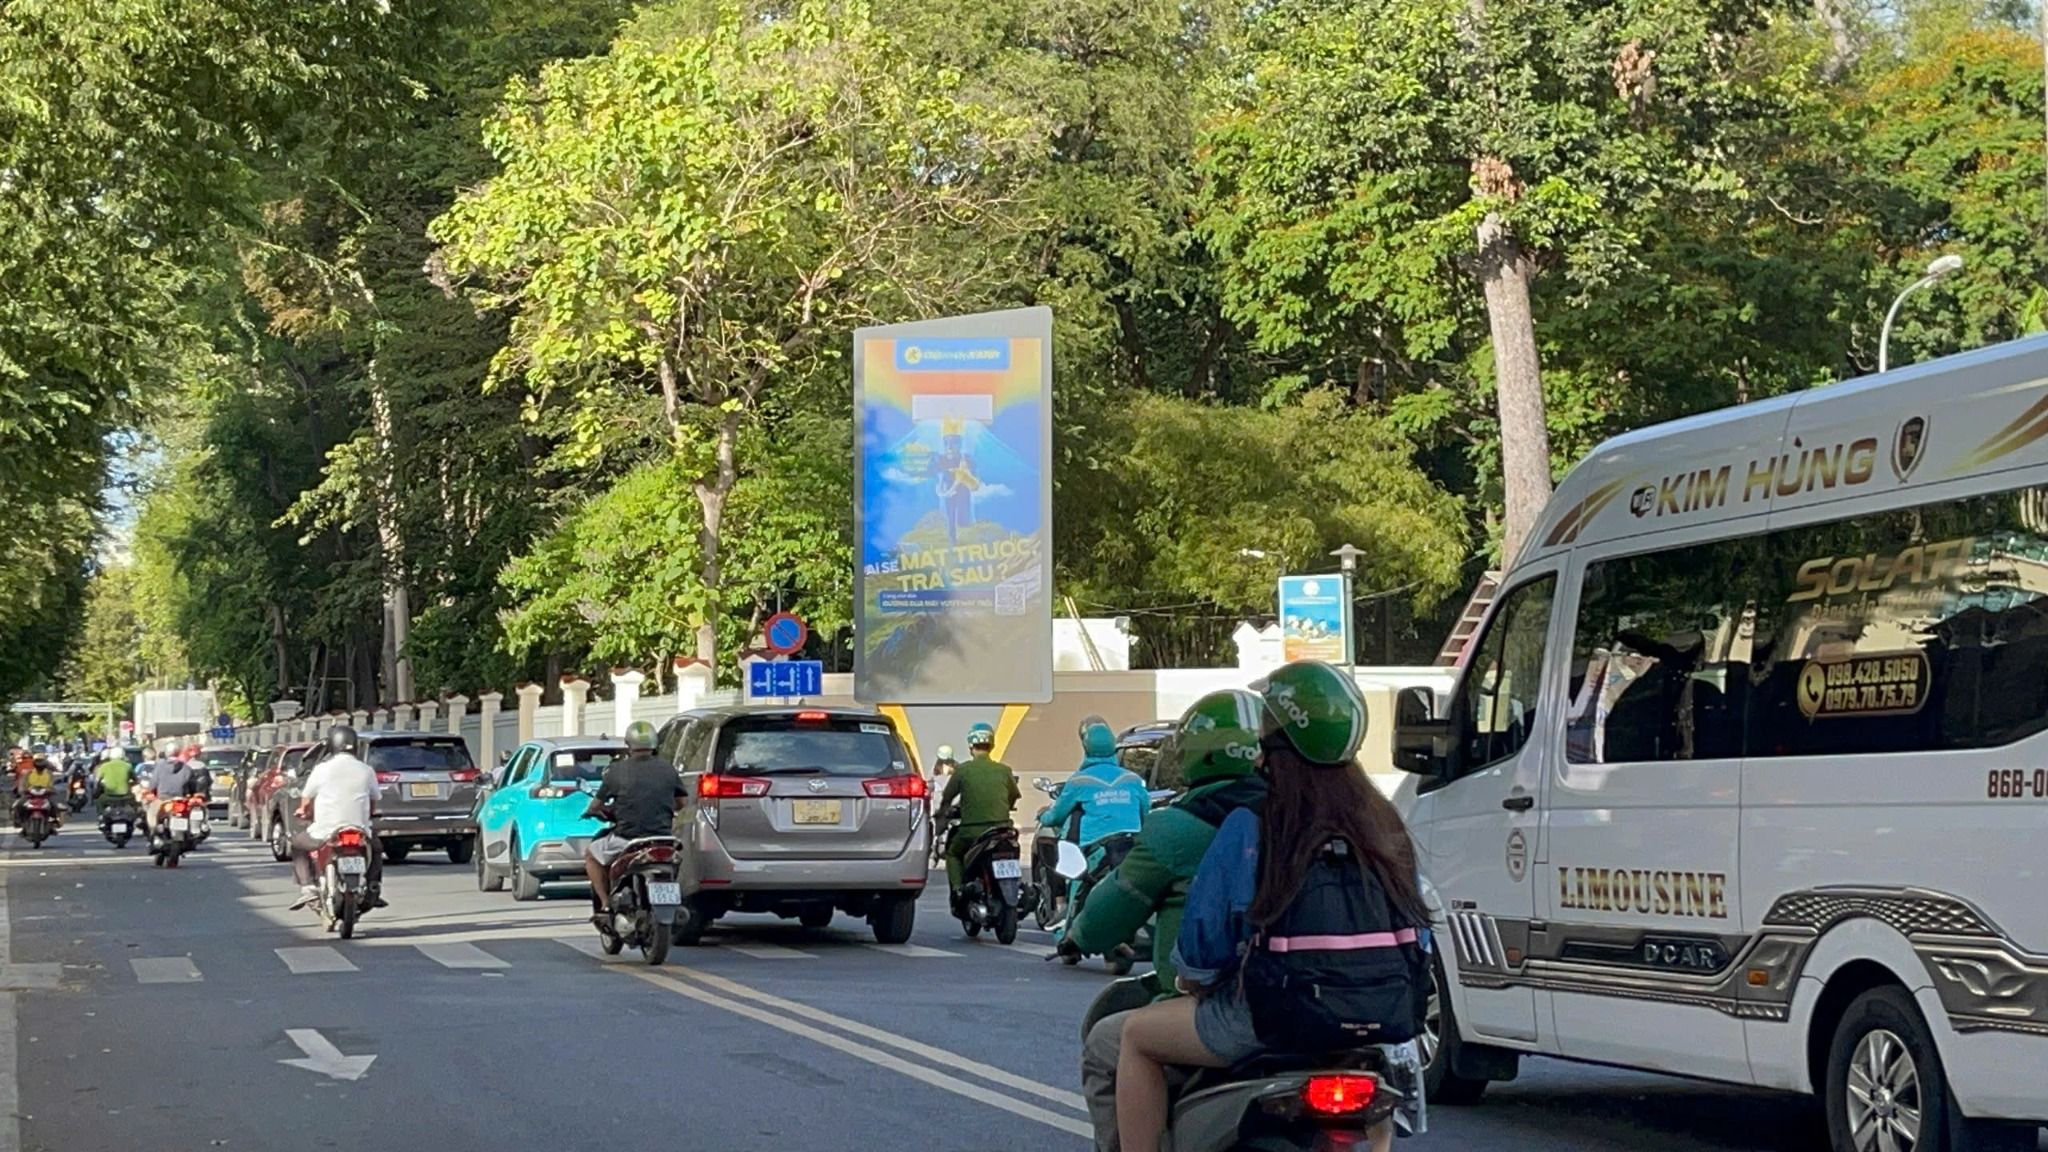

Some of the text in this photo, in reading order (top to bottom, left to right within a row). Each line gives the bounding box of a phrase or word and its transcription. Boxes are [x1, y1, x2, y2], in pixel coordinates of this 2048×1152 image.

[1656, 436, 1877, 517] KIM HÙNG
[951, 564, 993, 586] SAU
[1279, 687, 1309, 728] Grab
[1825, 683, 1917, 710] 0979.70.75.79
[1988, 769, 2048, 798] 86B-0
[1559, 867, 1728, 919] LIMOUSINE
[1644, 943, 1716, 969] DCAR
